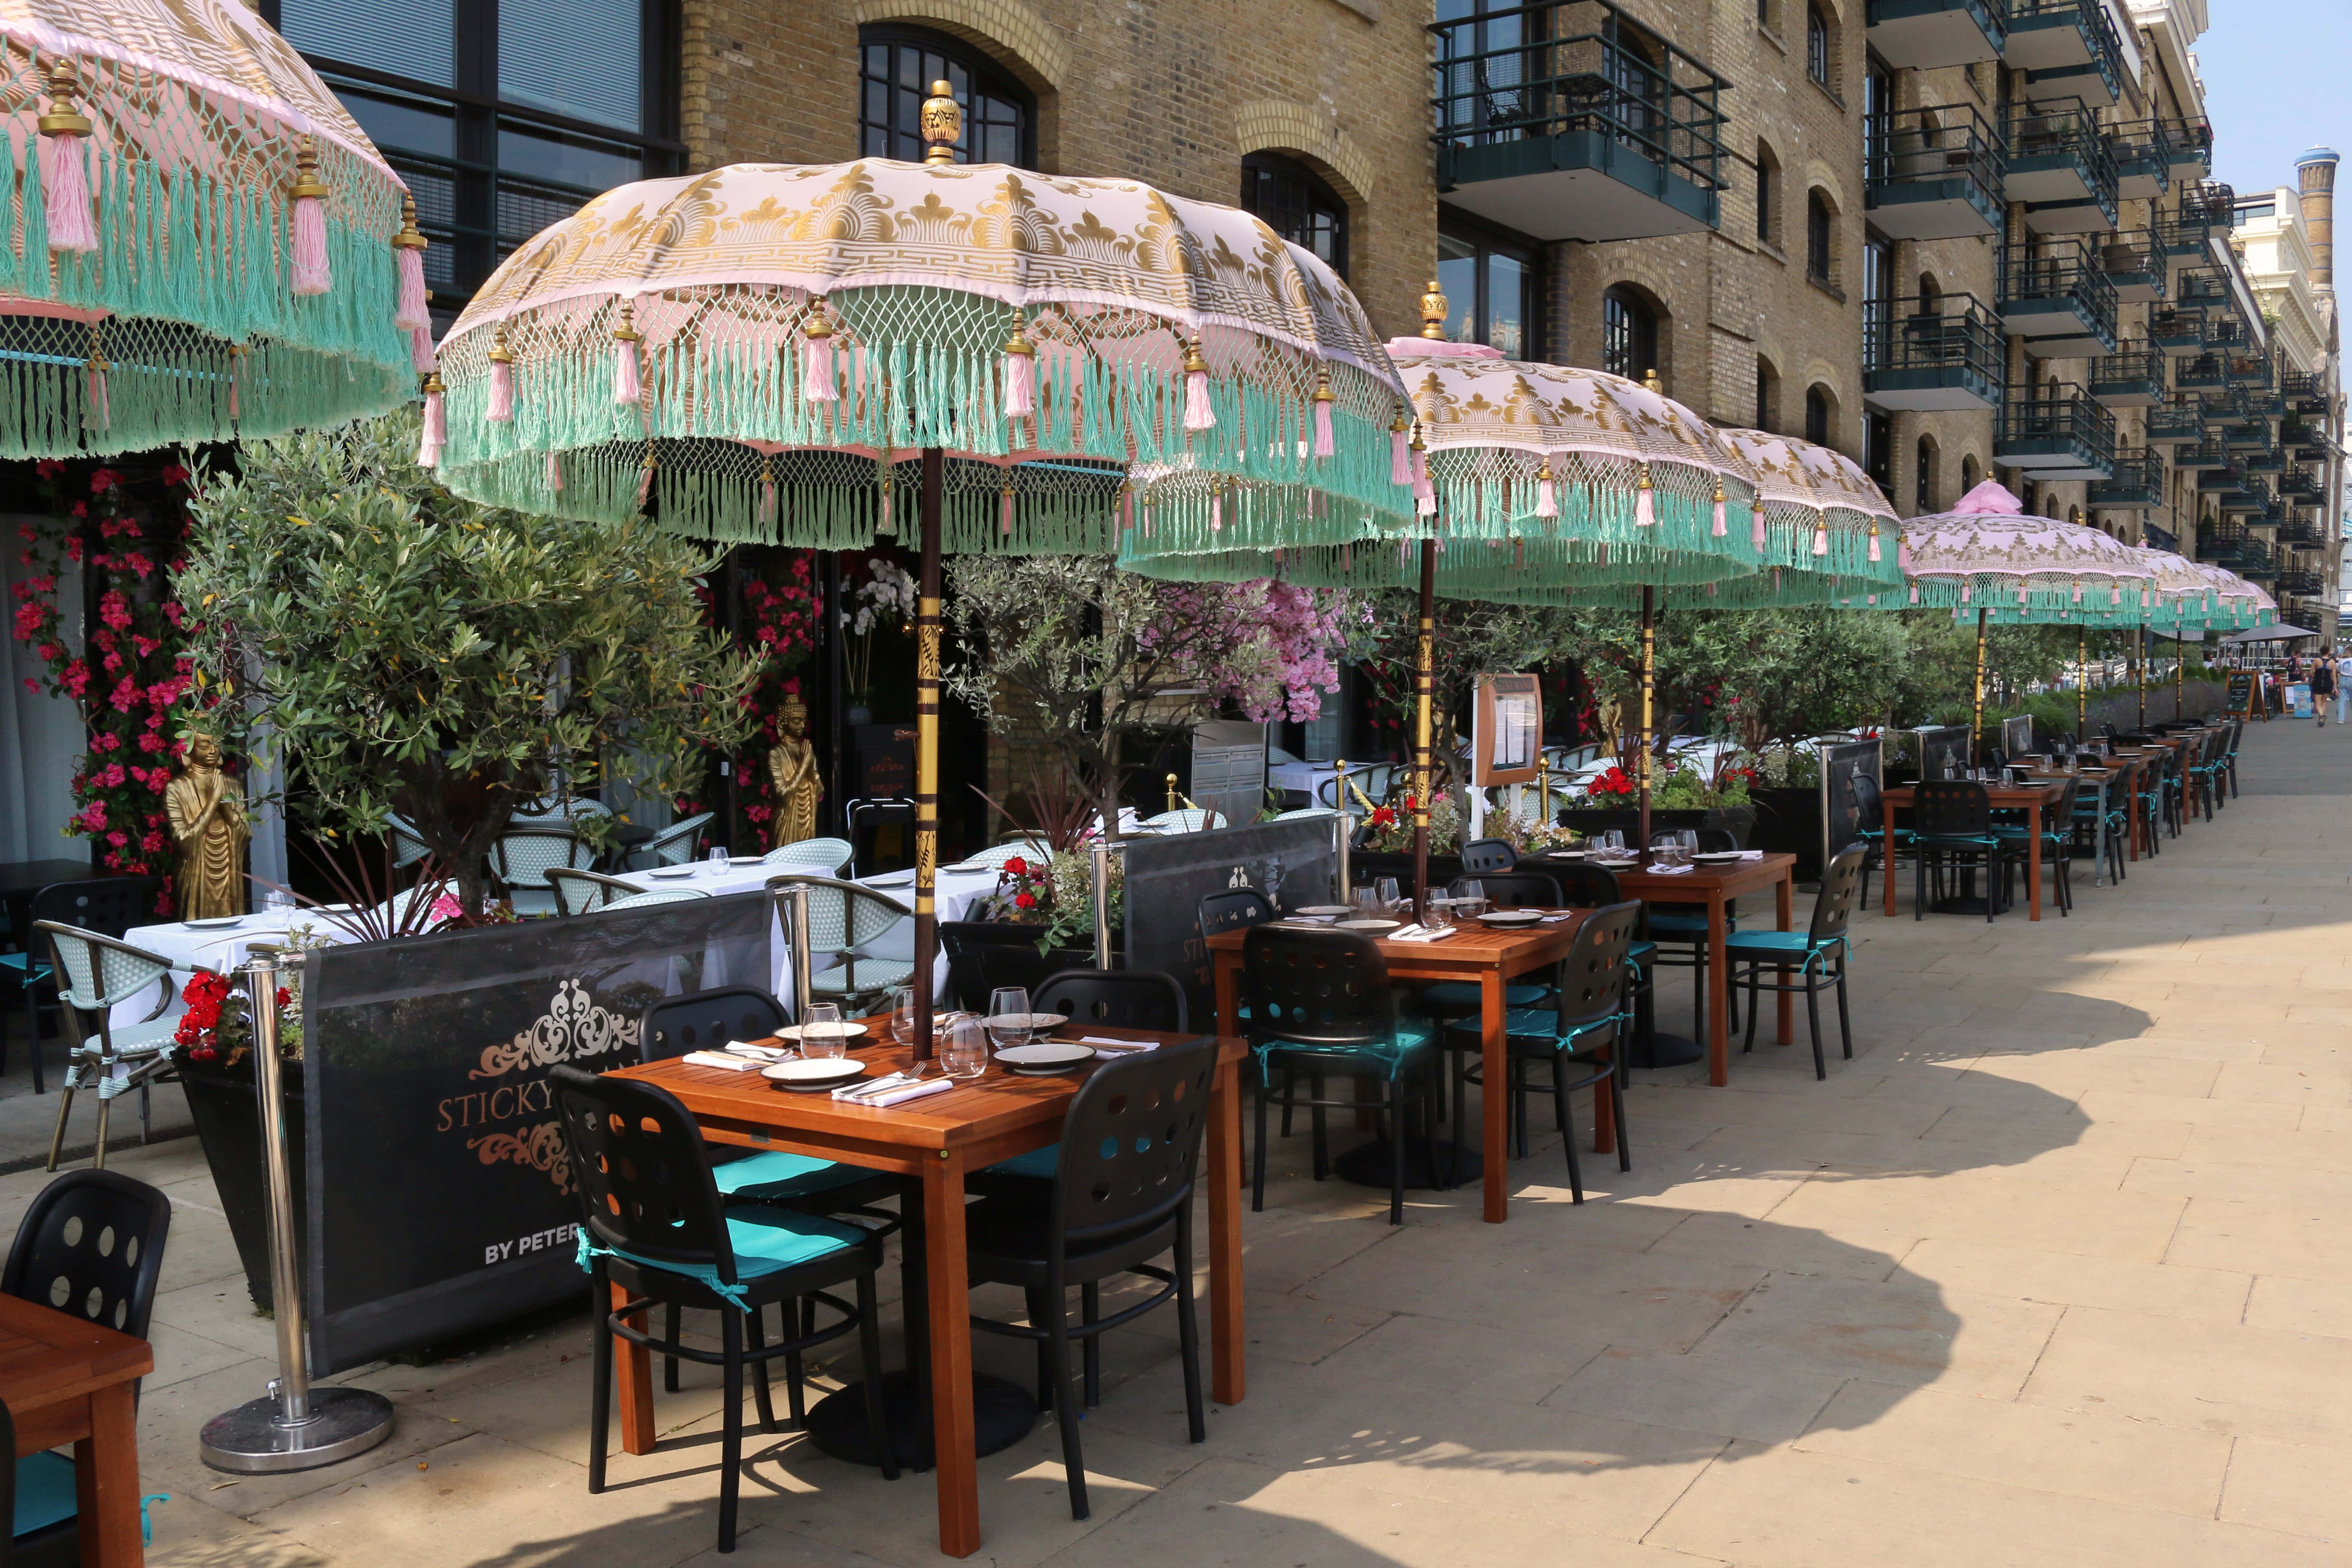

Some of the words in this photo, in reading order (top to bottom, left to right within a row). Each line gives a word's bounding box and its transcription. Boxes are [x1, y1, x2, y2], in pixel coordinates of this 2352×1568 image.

[437, 1079, 553, 1132] STICKY
[485, 1240, 514, 1265] BY
[519, 1222, 581, 1255] PETER
